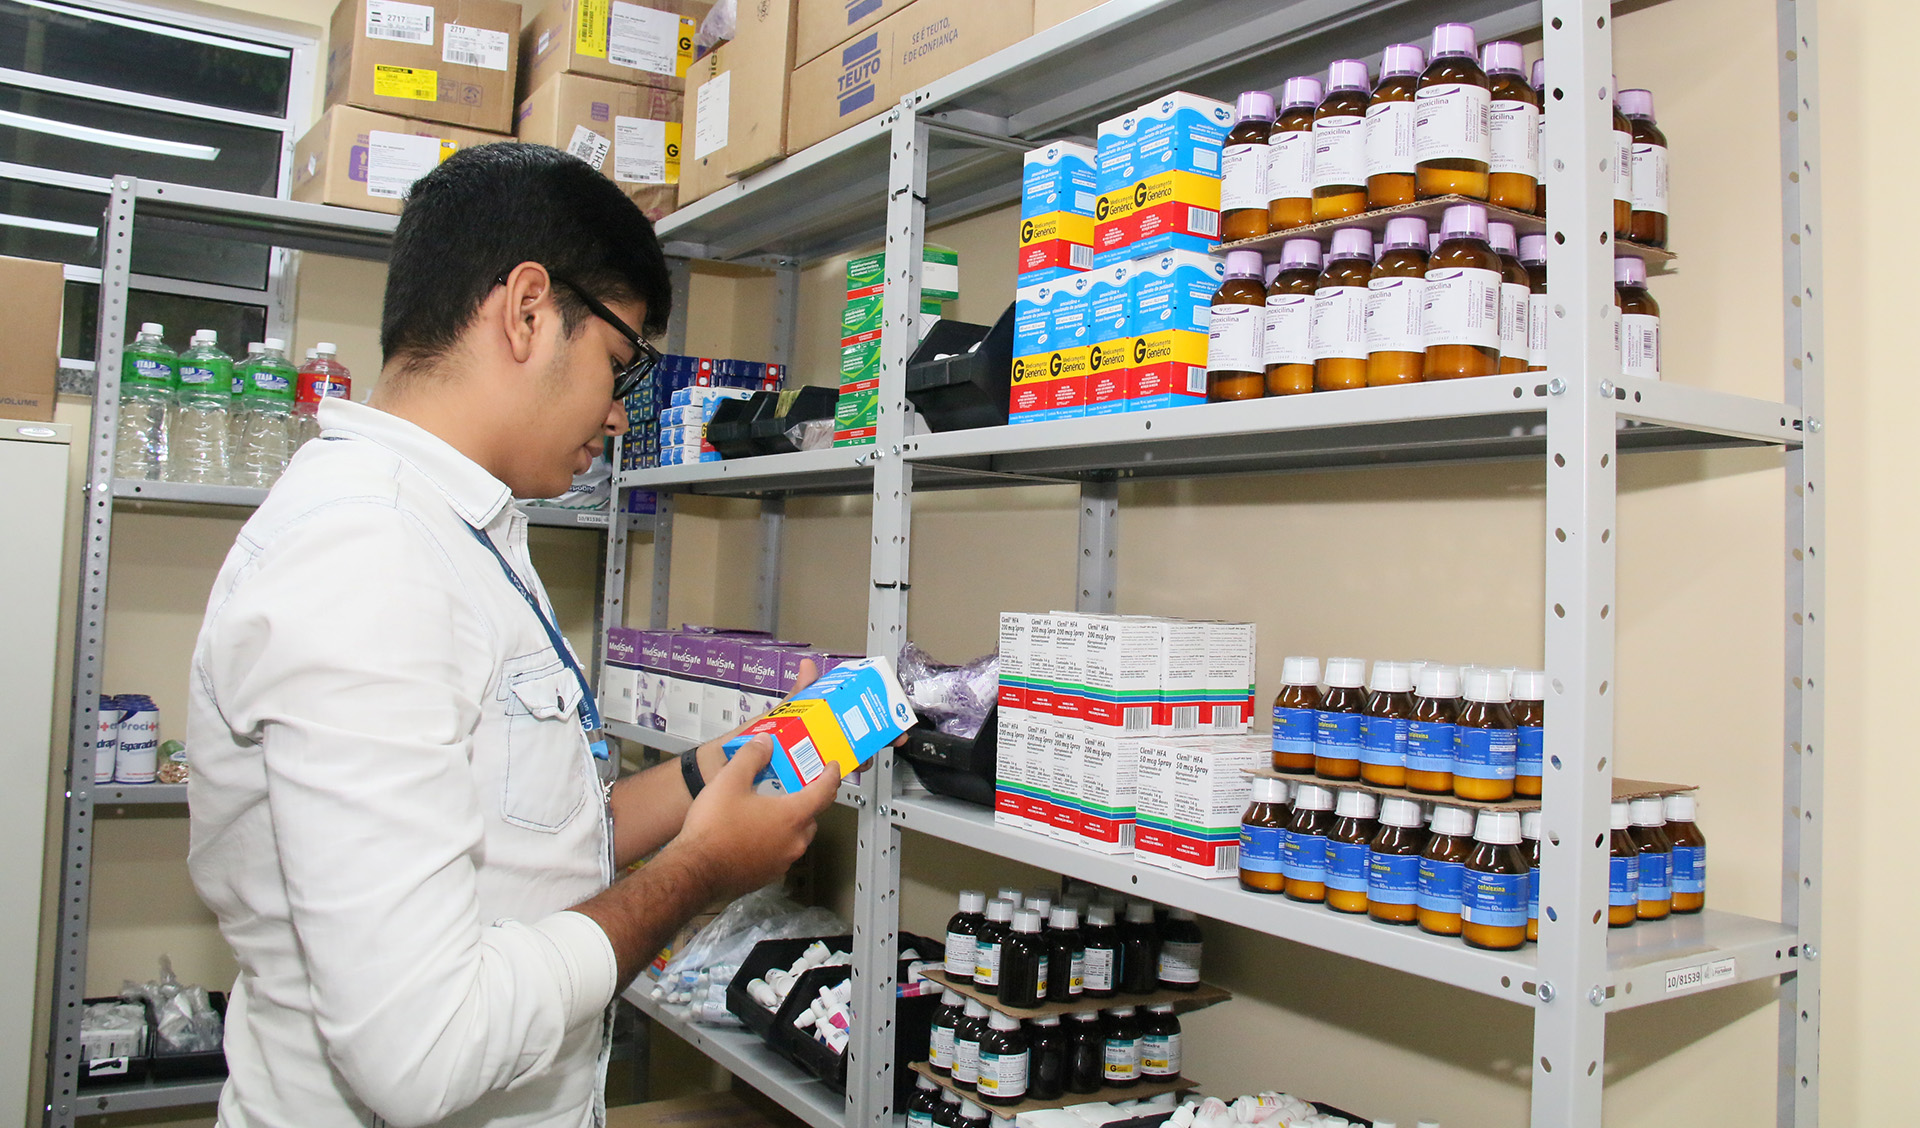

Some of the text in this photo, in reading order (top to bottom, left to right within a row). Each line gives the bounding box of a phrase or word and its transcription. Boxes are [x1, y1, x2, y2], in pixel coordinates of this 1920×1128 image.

[387, 15, 405, 24] 2717
[450, 25, 466, 35] 2717
[912, 32, 919, 45] SE
[921, 26, 926, 41] É
[680, 37, 692, 51] G
[903, 28, 958, 65] É DE CONFIANÇA
[838, 58, 881, 92] TEUTO
[592, 143, 609, 170] CHIM
[667, 143, 679, 158] G
[1135, 182, 1147, 208] G
[1147, 187, 1173, 202] Genérico
[1097, 196, 1110, 221] G
[1021, 220, 1034, 244] G
[1034, 225, 1057, 239] Genérico
[1134, 338, 1146, 364] G
[1147, 347, 1171, 360] Genérico
[1050, 353, 1062, 377] G
[1090, 346, 1102, 371] G
[1102, 354, 1125, 367] Genérico
[1013, 359, 1024, 383] G
[1024, 367, 1048, 380] Genérico
[1062, 362, 1086, 375] Genérico
[608, 641, 634, 654] MediSafe
[642, 646, 668, 659] MediSafe
[672, 651, 701, 665] MediSafe
[706, 657, 735, 670] MediSafe
[742, 662, 775, 678] MediSafe
[1156, 750, 1166, 758] HFA
[1193, 756, 1203, 764] HFA
[1147, 758, 1157, 767] mcg
[1158, 758, 1172, 769] Spray
[1176, 761, 1209, 775] 50 mcg Spray
[1667, 971, 1701, 988] 10/81539
[1110, 1064, 1118, 1073] G
[1145, 1059, 1153, 1068] G
